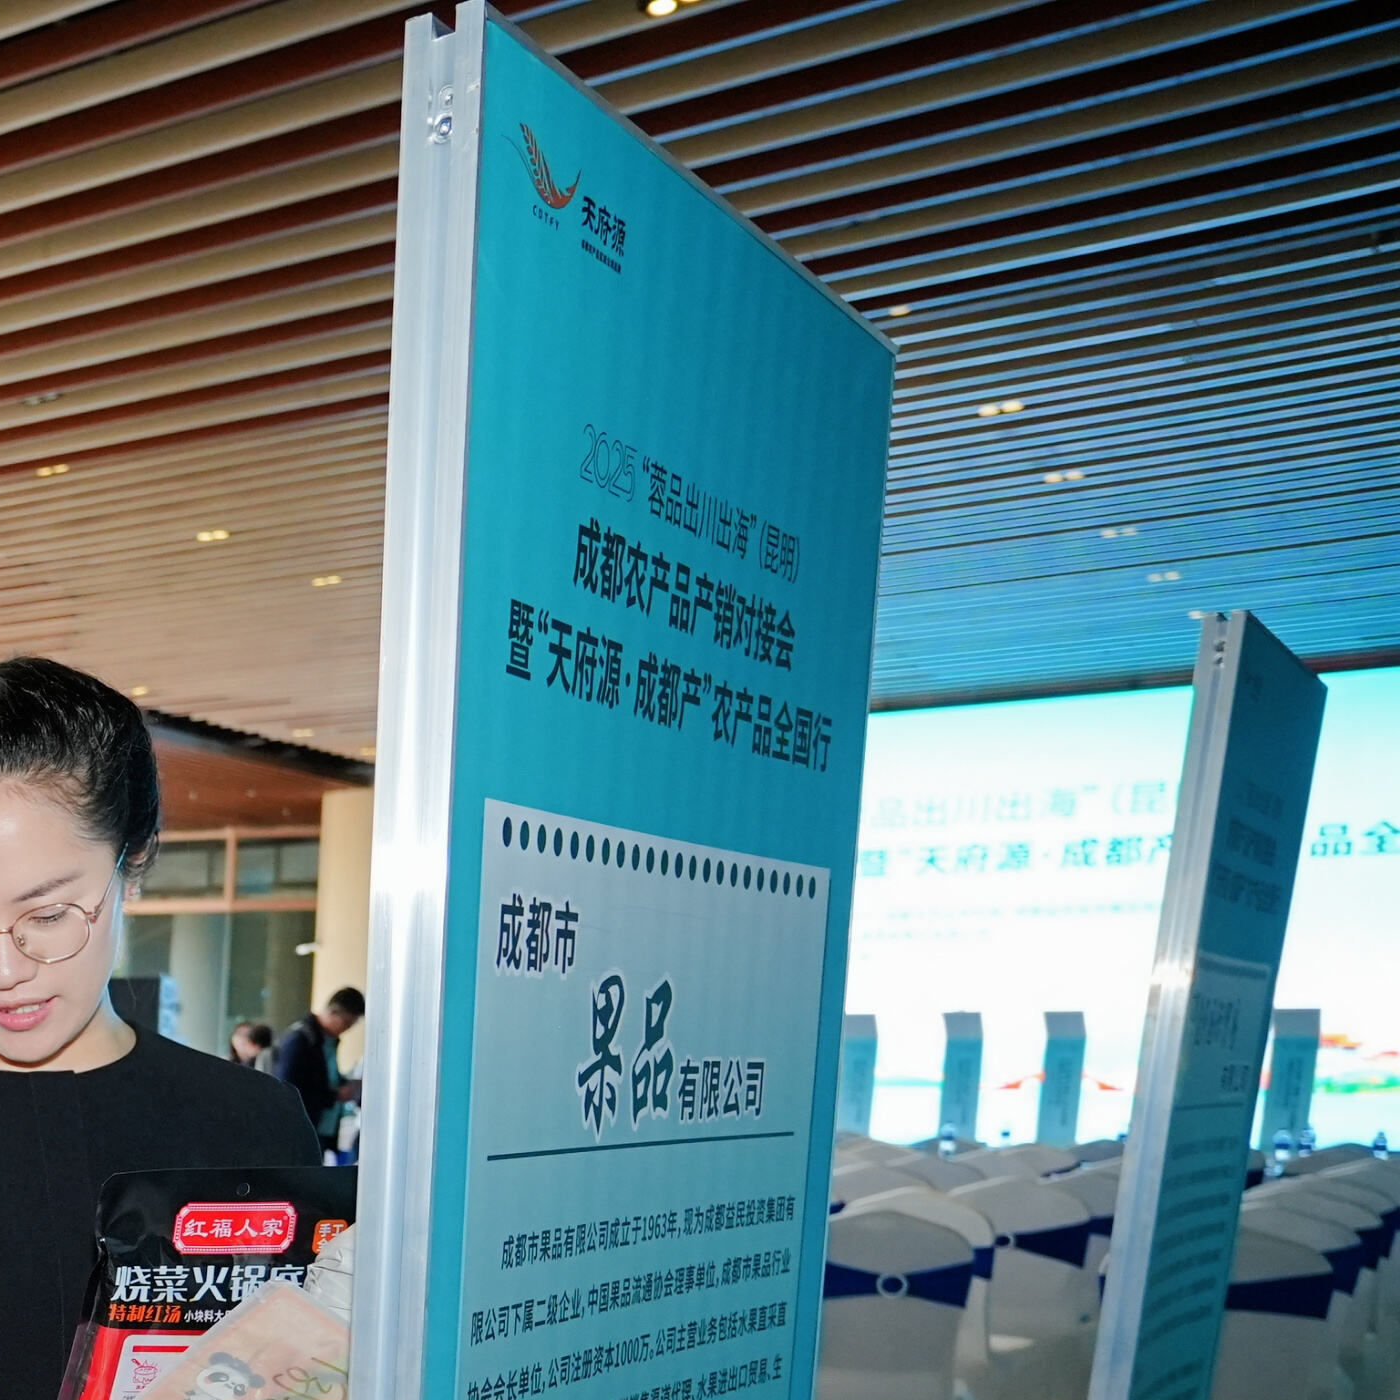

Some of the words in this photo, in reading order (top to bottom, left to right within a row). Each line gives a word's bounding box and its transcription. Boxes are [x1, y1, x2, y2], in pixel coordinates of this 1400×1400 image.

[581, 195, 626, 256] 天府源
[580, 423, 636, 503] 2025
[573, 516, 796, 673] 成都农产品产销对接会
[495, 893, 580, 975] 成都市
[577, 974, 675, 1136] 果品
[678, 1059, 766, 1122] 有限公司
[183, 1216, 284, 1239] 红福人家
[108, 1303, 182, 1324] 特制红汤
